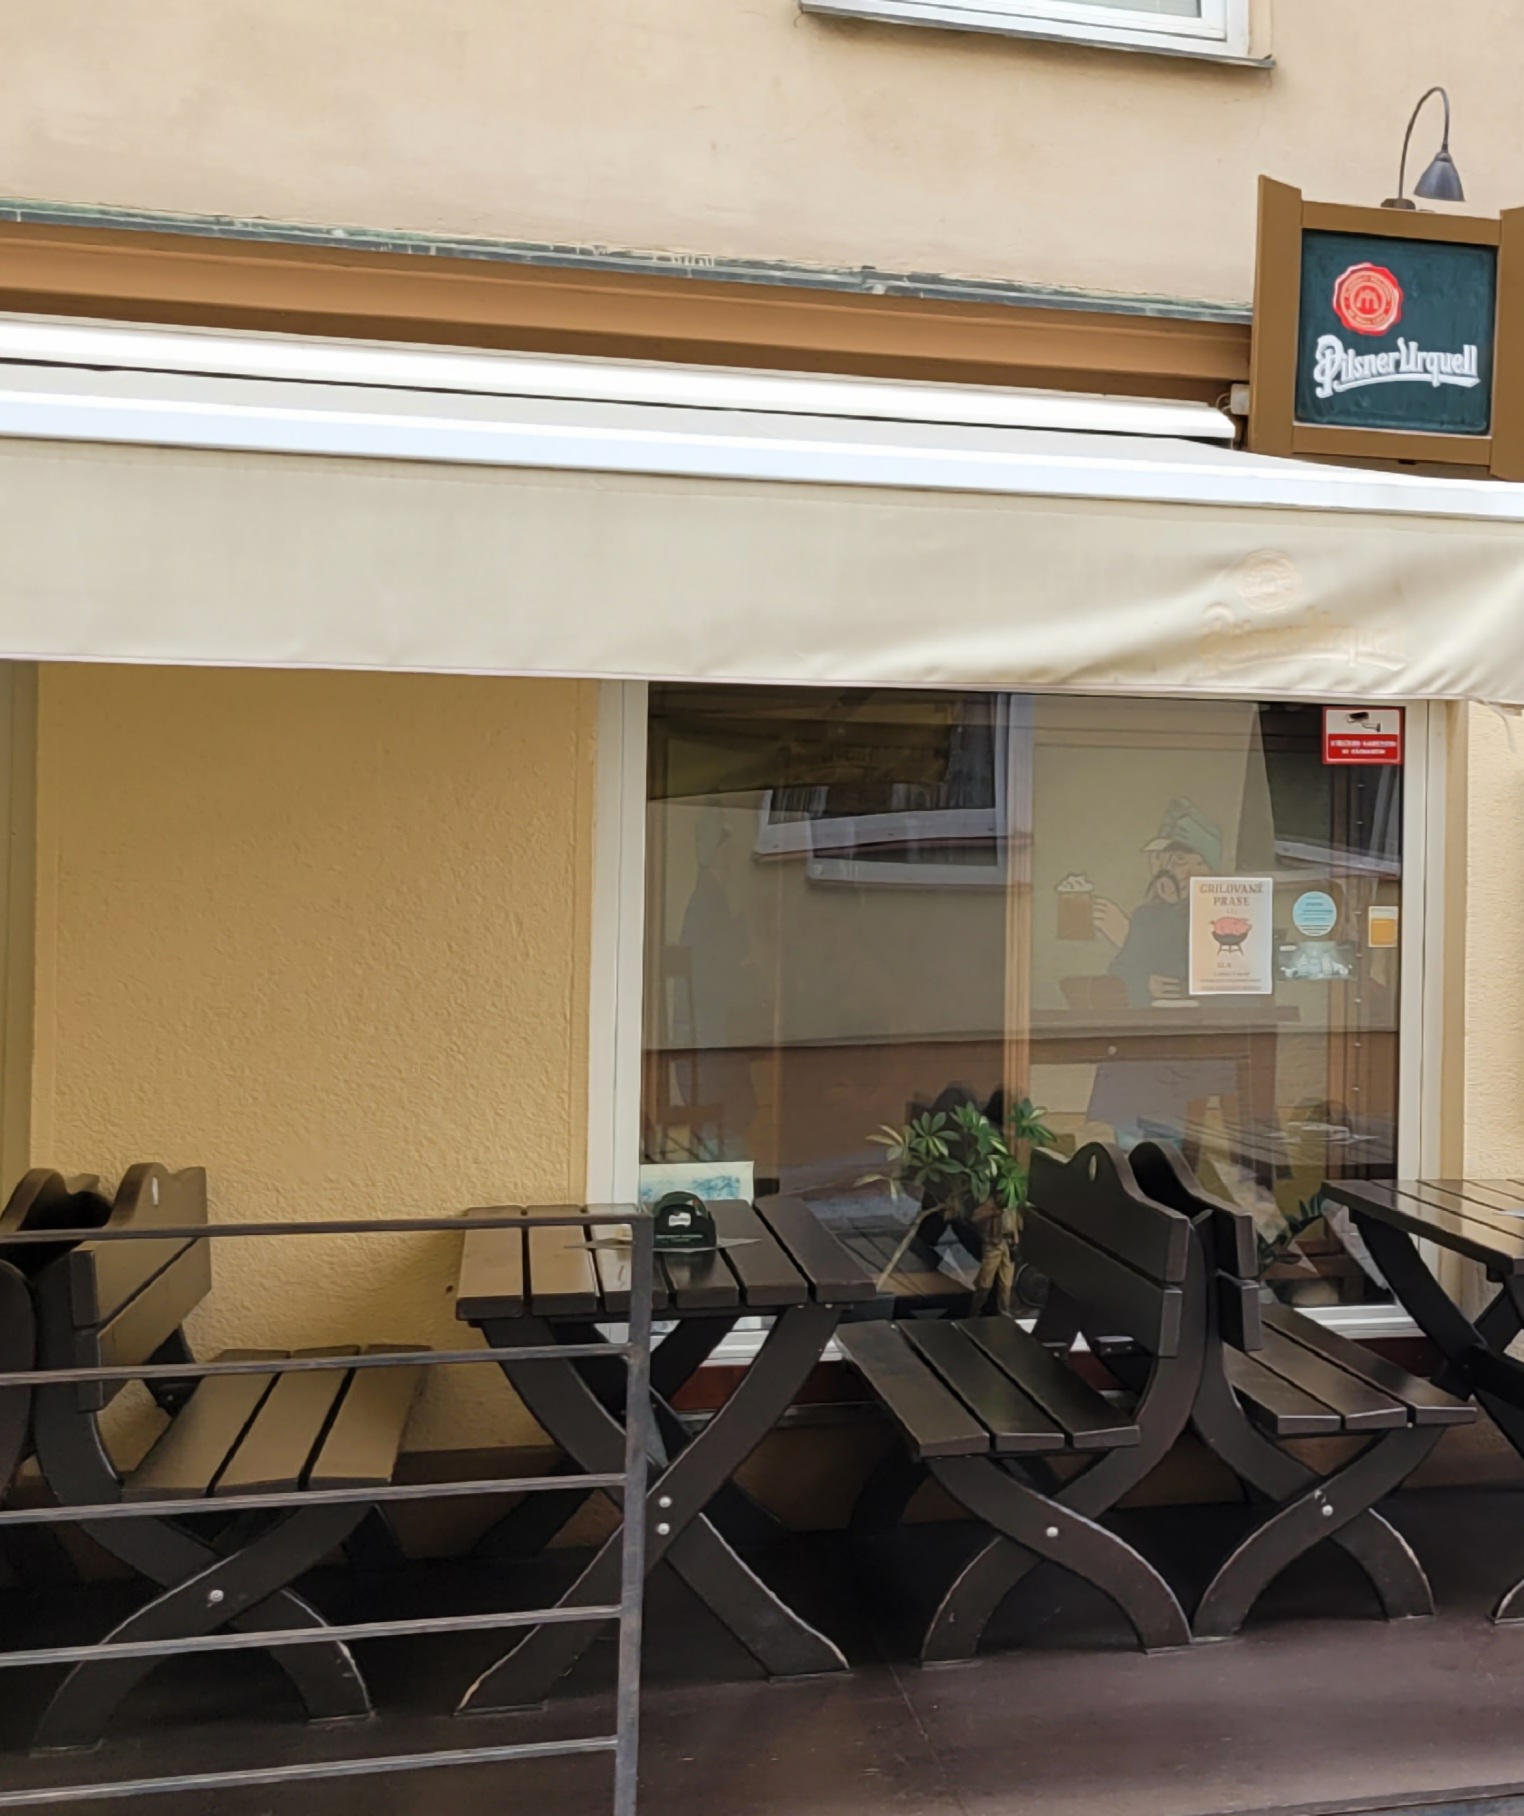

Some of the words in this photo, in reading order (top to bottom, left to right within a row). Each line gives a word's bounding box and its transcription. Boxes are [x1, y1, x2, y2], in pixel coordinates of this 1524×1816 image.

[1313, 334, 1400, 398] Pilsner
[1397, 337, 1478, 388] Urquell
[1213, 896, 1250, 907] PRASE
